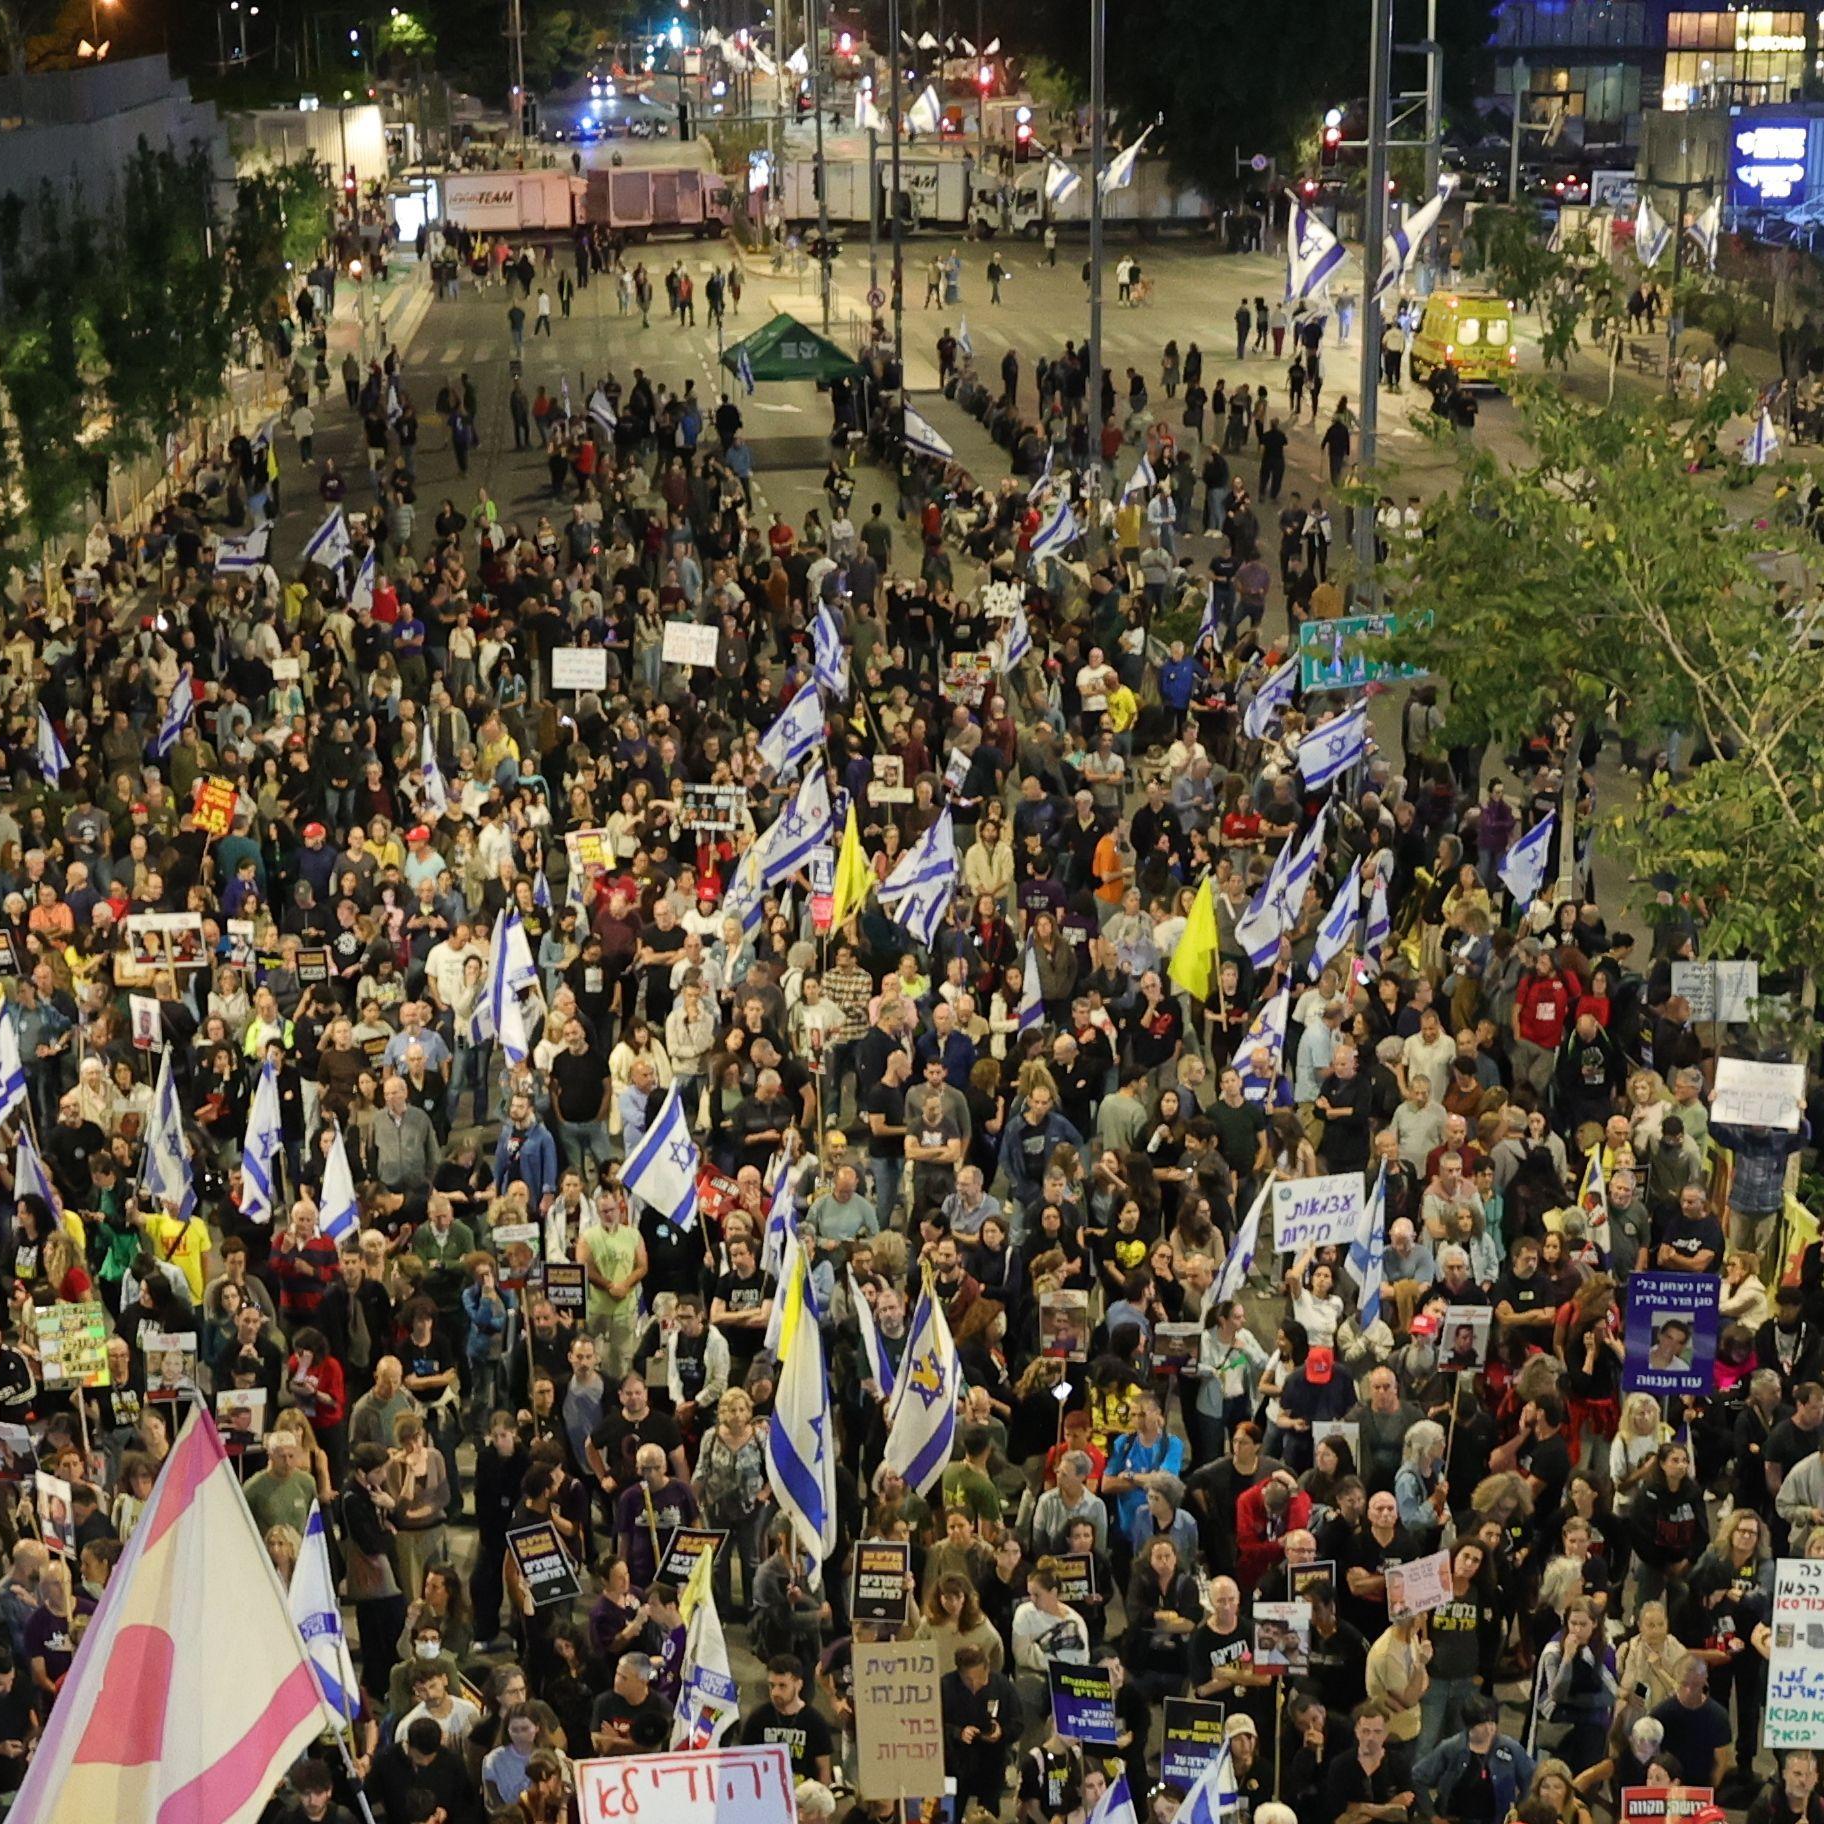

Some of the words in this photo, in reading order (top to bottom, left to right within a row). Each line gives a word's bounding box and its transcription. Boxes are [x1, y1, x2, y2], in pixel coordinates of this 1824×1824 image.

[1287, 1192, 1358, 1222] עצמאות
[1278, 1223, 1333, 1249] חירות
[865, 1655, 934, 1676] מורשת
[876, 1742, 940, 1761] קברות
[596, 1766, 640, 1818] לא
[651, 1760, 770, 1804] יהודי
